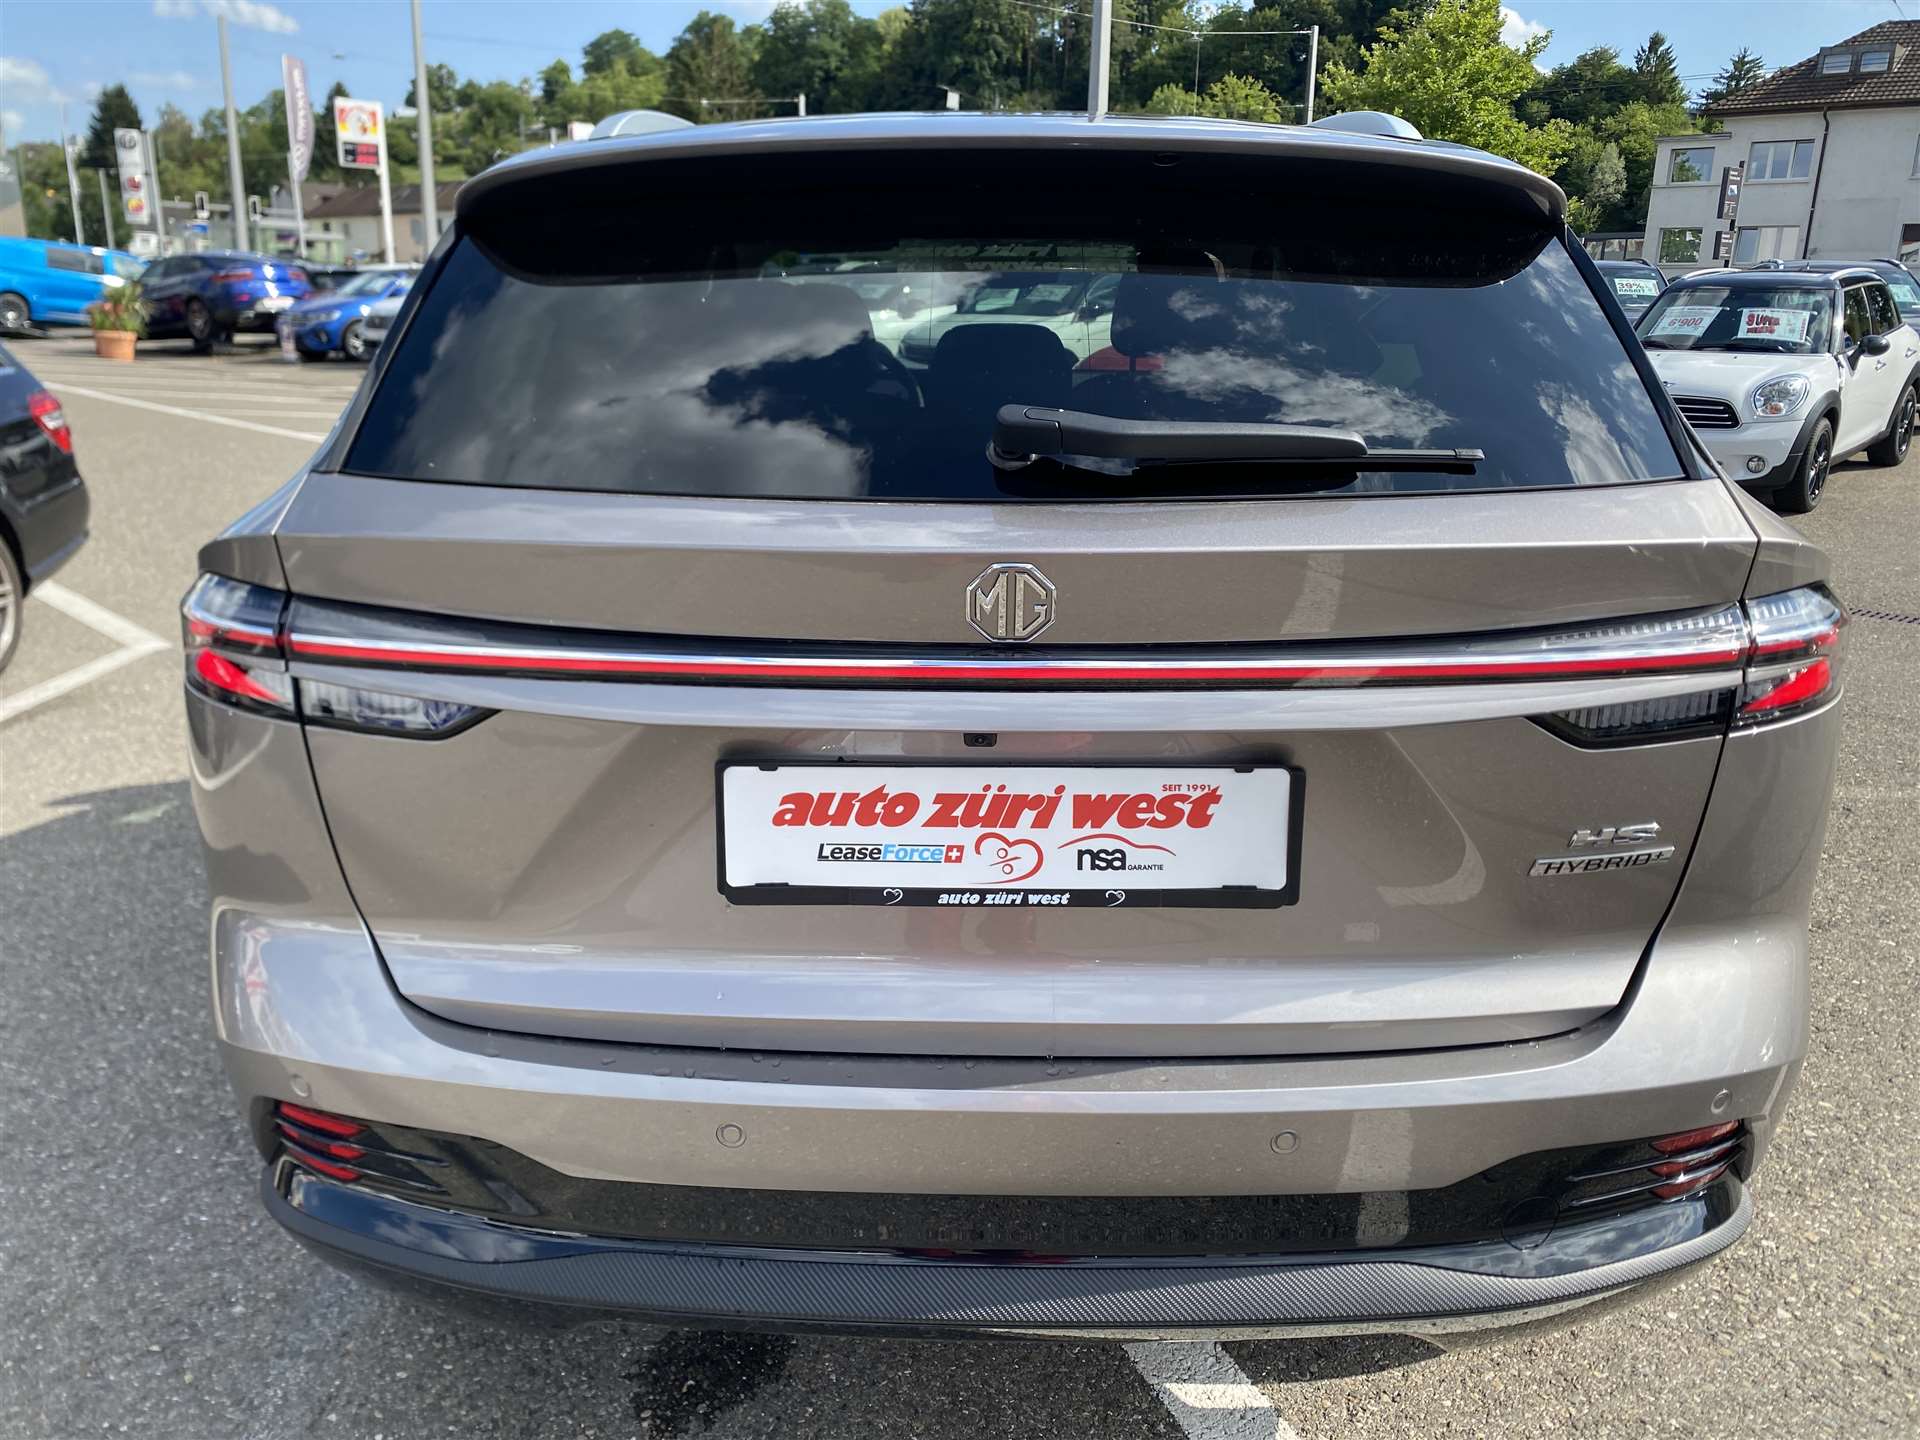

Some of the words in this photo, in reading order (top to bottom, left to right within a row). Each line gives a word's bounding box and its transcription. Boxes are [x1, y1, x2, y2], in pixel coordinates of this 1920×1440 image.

[975, 572, 1048, 637] MG
[1162, 784, 1183, 792] SEIT
[1186, 784, 1212, 792] 1991
[772, 784, 920, 828] auto
[921, 784, 1066, 829] züri
[1072, 785, 1223, 829] west
[1567, 820, 1662, 849] HS
[817, 844, 944, 861] LeaseForce
[1077, 849, 1127, 871] nsa
[937, 892, 980, 905] auto
[983, 891, 1024, 905] züri
[1027, 892, 1071, 905] west
